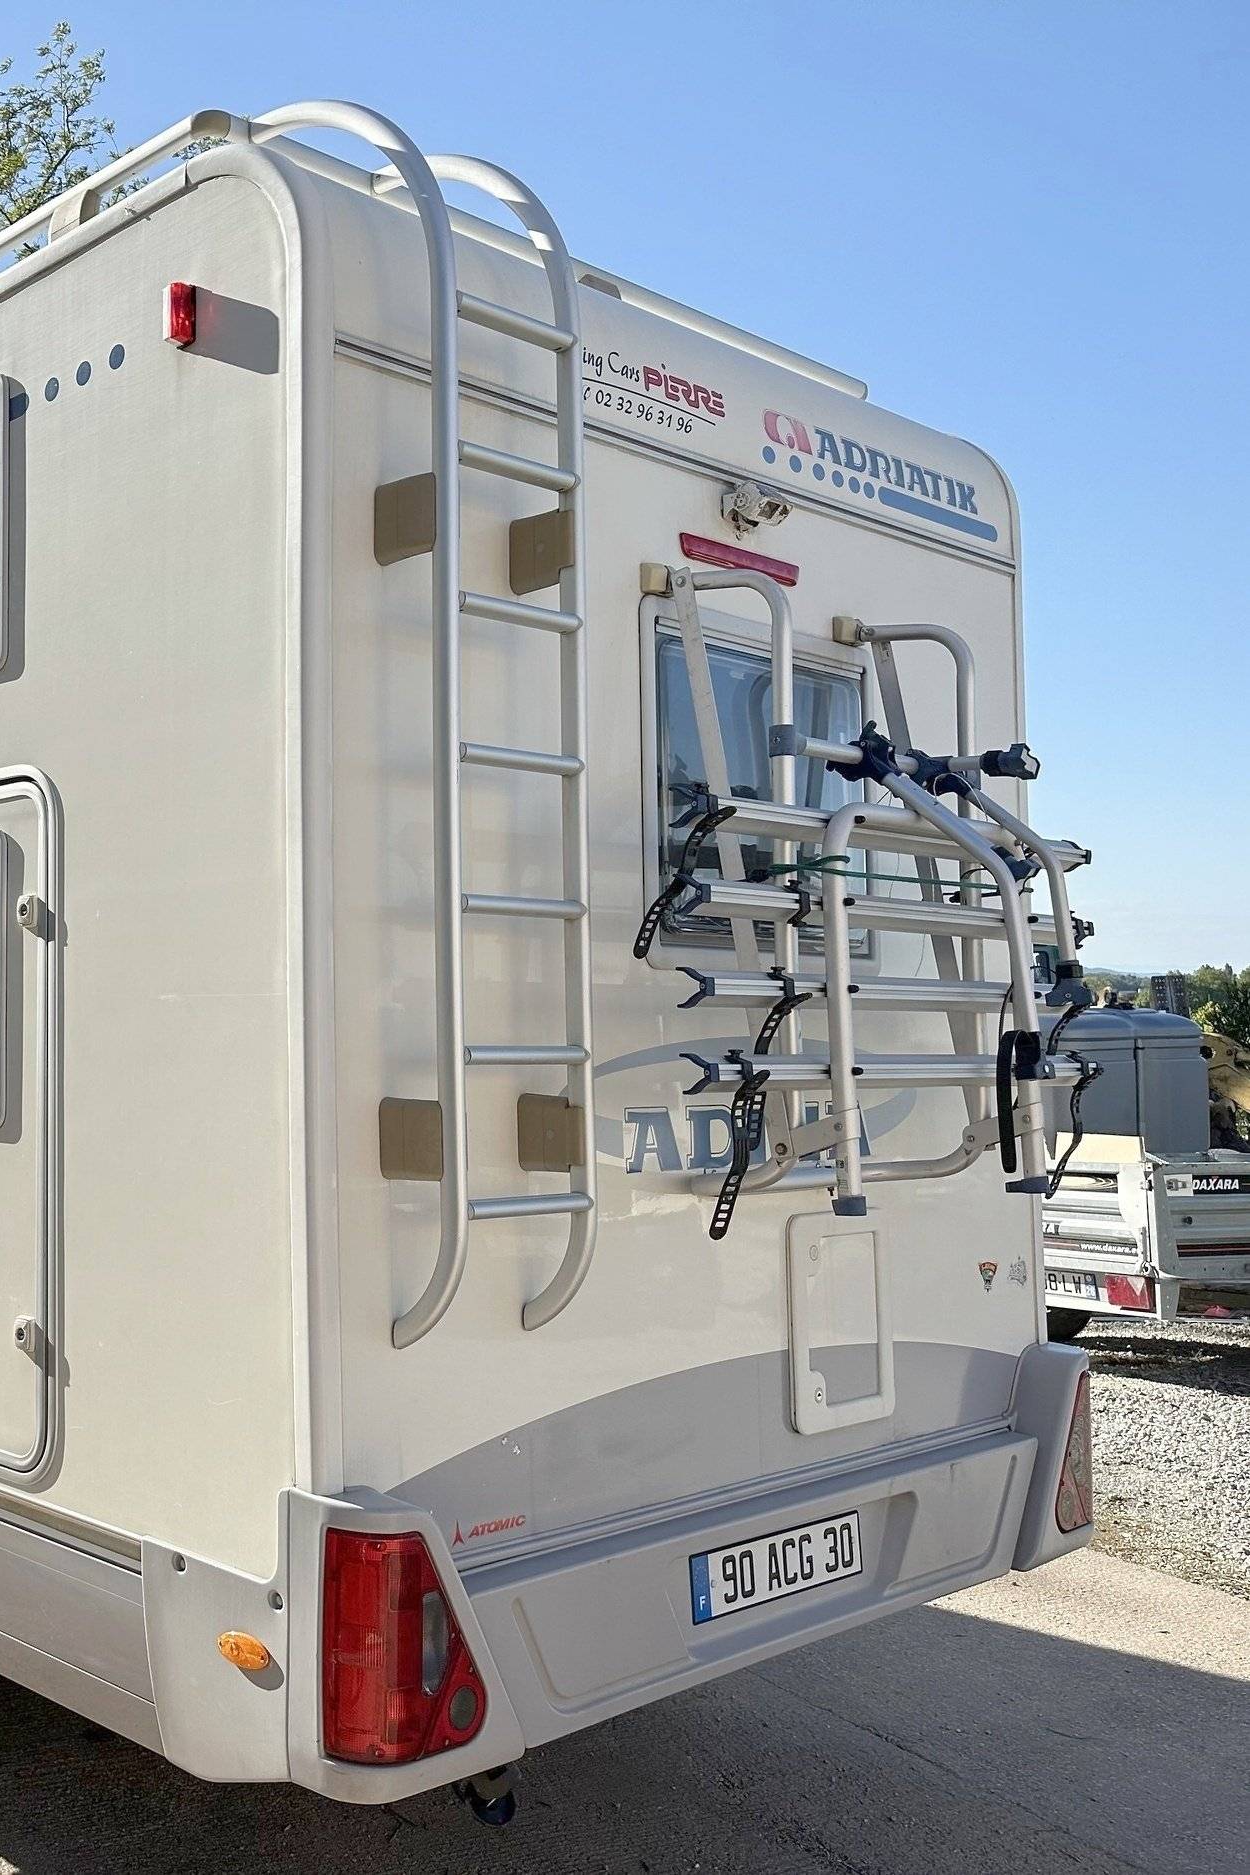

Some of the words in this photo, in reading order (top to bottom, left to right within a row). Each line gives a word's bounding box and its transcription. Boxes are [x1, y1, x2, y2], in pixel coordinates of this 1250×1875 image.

[607, 351, 640, 383] Cars
[595, 389, 612, 408] 02
[616, 396, 633, 414] 32
[636, 403, 654, 422] 96
[657, 410, 673, 428] 31
[676, 416, 693, 434] 96
[814, 426, 978, 515] ADRIATIK
[1191, 1178, 1240, 1191] DAXARA
[468, 1514, 527, 1539] ATOMIC
[721, 1549, 756, 1604] 90
[768, 1533, 814, 1592] ACG
[823, 1522, 854, 1573] 30
[699, 1595, 707, 1611] F
